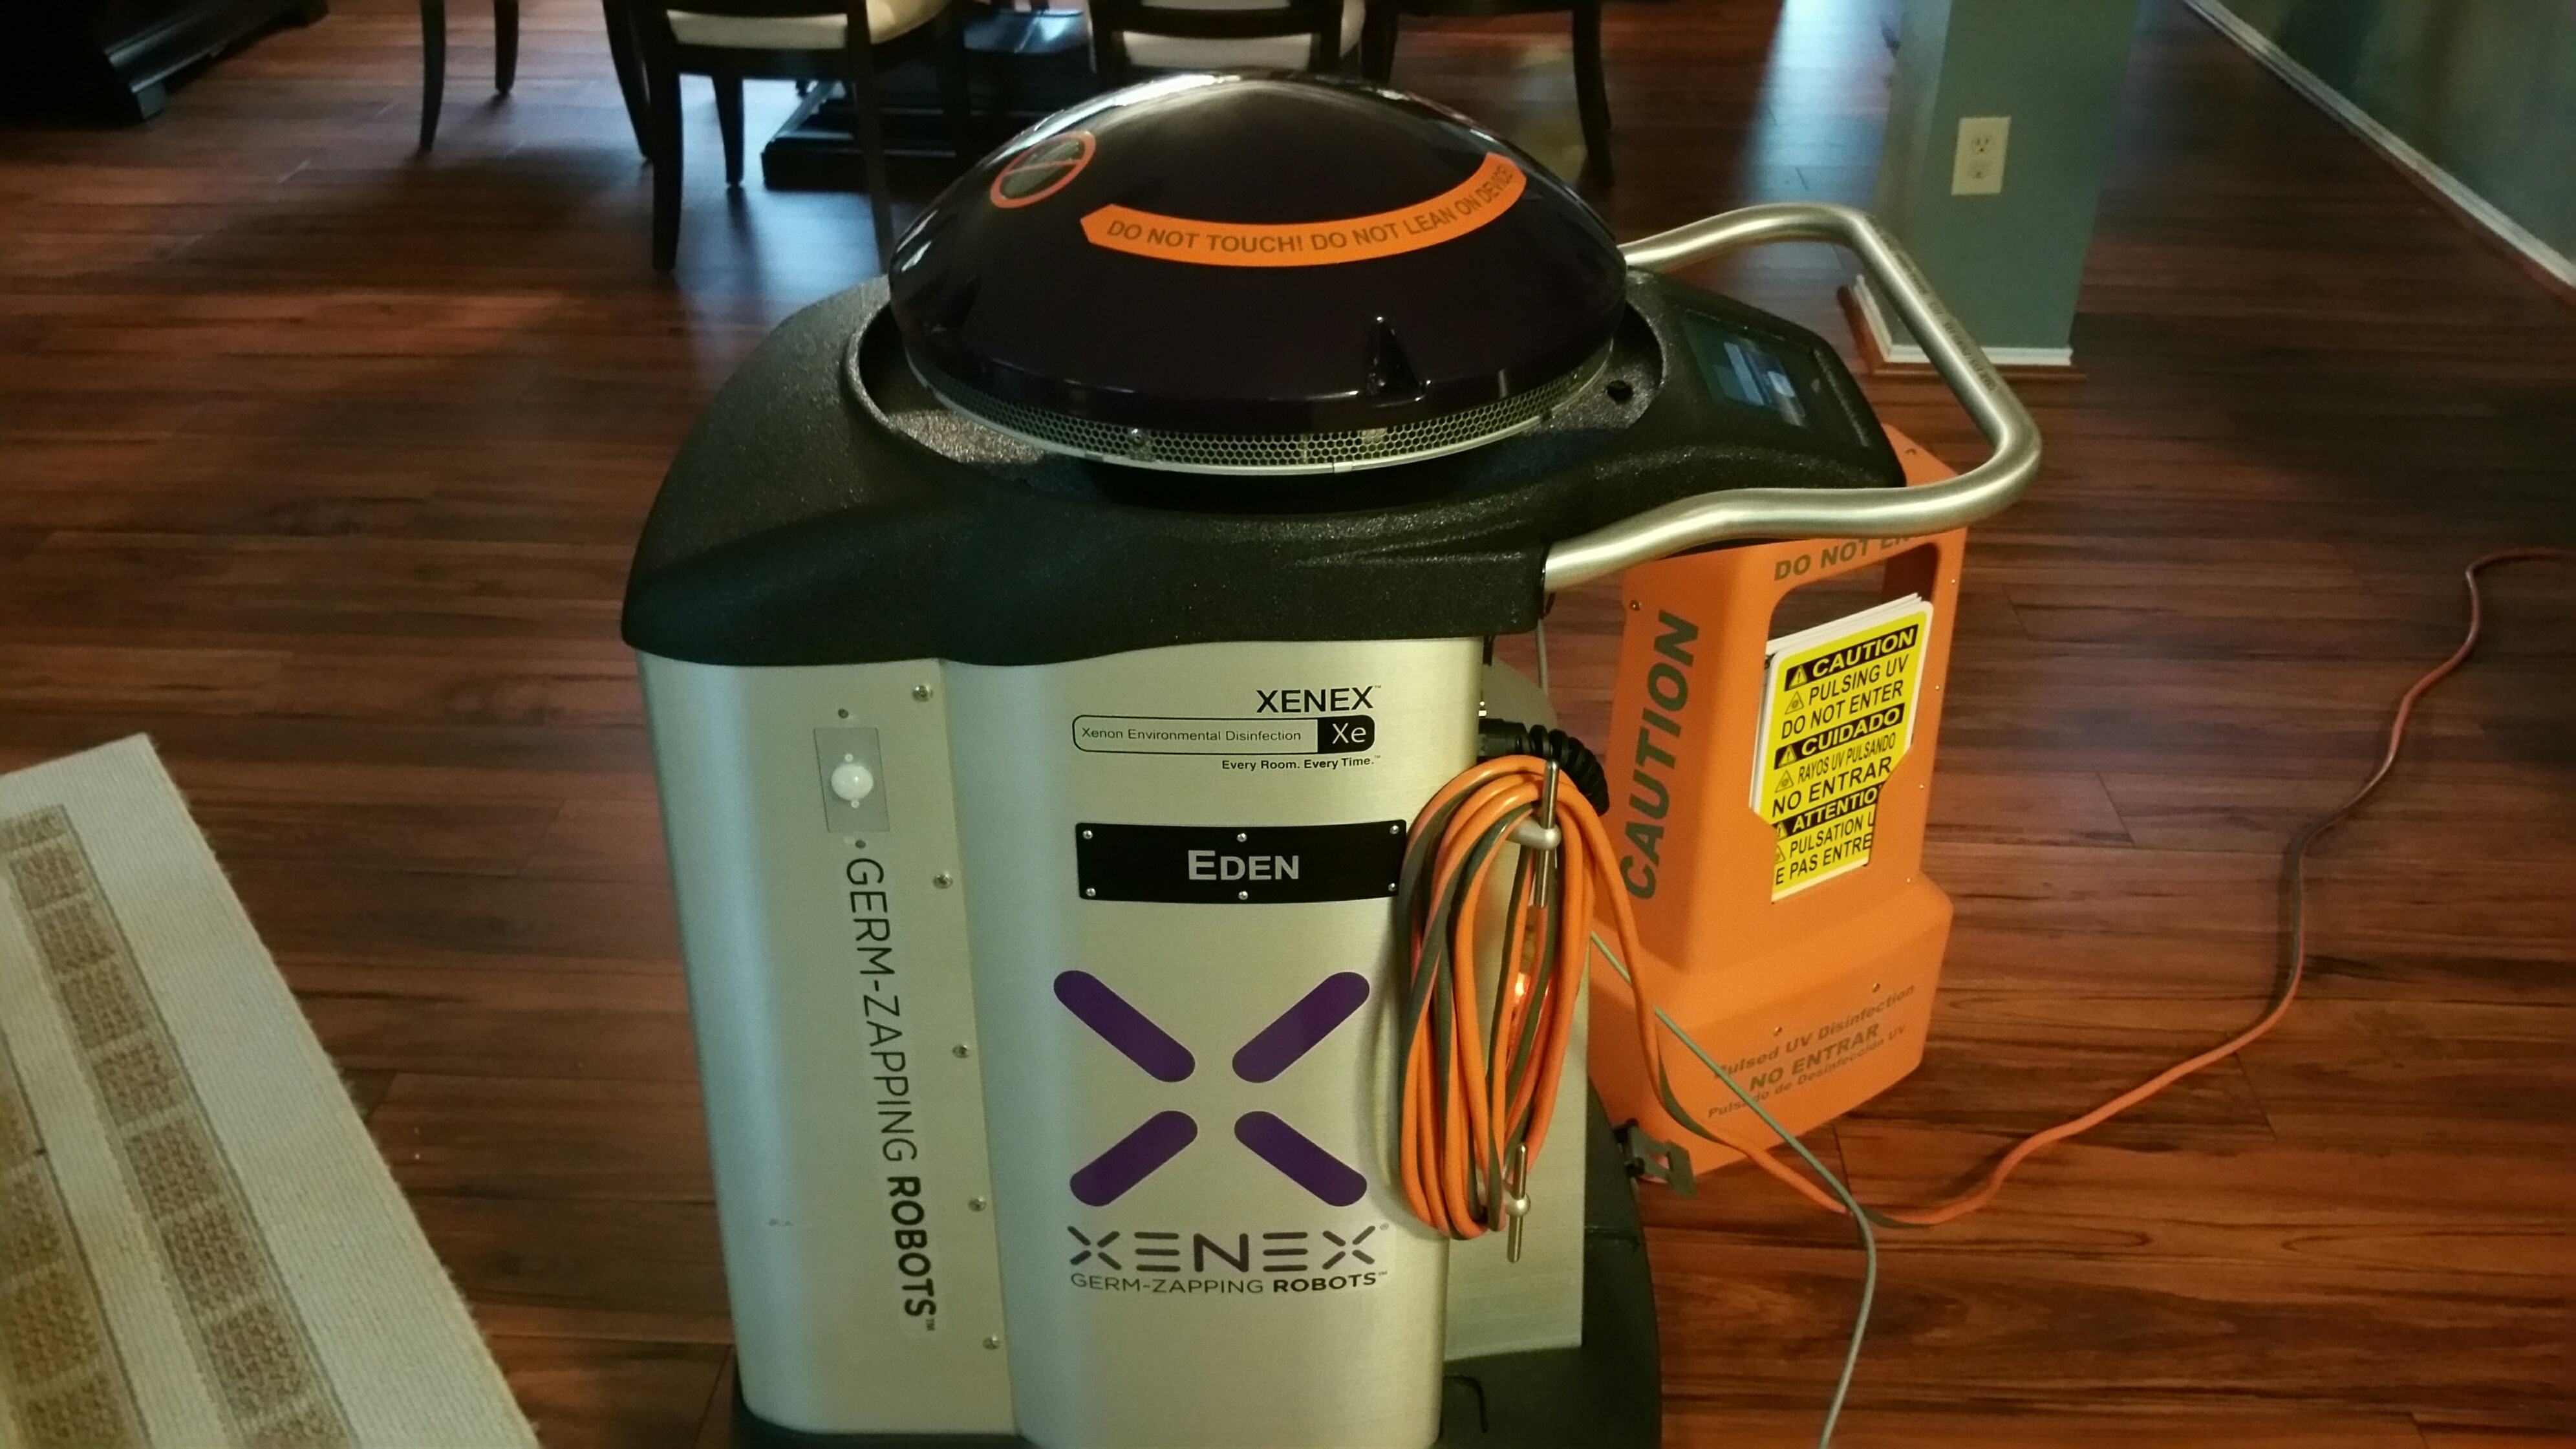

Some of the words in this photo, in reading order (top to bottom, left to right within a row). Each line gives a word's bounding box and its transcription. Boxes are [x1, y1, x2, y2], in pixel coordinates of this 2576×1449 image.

[1106, 220, 1142, 240] DO
[1147, 228, 1200, 248] NOT
[1206, 234, 1303, 253] TOUCH!
[1311, 232, 1347, 250] DO
[1352, 223, 1399, 245] NOT
[1402, 206, 1457, 234] LEAN
[1454, 195, 1483, 215] ON
[1774, 555, 1811, 581] DO
[1821, 539, 1868, 568] NOT
[1812, 628, 1914, 677] CAUTION
[1256, 686, 1373, 713] XENEX
[1809, 664, 1880, 705] PULSING
[1885, 654, 1909, 678] UV
[1082, 727, 1124, 739] Xenon
[1128, 729, 1221, 741] Environmental
[1225, 731, 1301, 741] Disinfection
[1331, 722, 1367, 744] Xe
[1782, 715, 1806, 739] DO
[1810, 700, 1845, 729] NOT
[1849, 680, 1904, 714] ENTER
[1801, 707, 1900, 756] CUIDADO
[1222, 759, 1256, 771] Every
[1261, 760, 1300, 770] Room.
[1304, 758, 1339, 770] Every
[1341, 756, 1375, 767] Time.
[1620, 610, 1699, 899] CAUTION
[1798, 757, 1829, 784] RAYOS
[1831, 750, 1848, 771] UV
[1845, 733, 1896, 769] PULSANDO
[1772, 791, 1801, 818] NO
[1809, 756, 1892, 803] ENTRAR
[1792, 786, 1879, 833] ATTENTIO
[1776, 866, 1785, 885] E
[1789, 853, 1818, 880] PAS
[1823, 832, 1873, 866] ENTRE
[1789, 814, 1863, 859] PULSATION
[1868, 811, 1874, 827] U
[1188, 850, 1300, 881] EDEN
[1785, 1032, 1813, 1053] UV
[1818, 985, 1916, 1040] Disinfection
[1750, 1067, 1784, 1091] NO
[1791, 1023, 1880, 1075] ENTRAR
[846, 857, 918, 1162] GERM-ZAPPING
[886, 1175, 937, 1318] ROBOTS
[1708, 1090, 1770, 1119] Pulsdo
[1775, 1082, 1792, 1095] de
[1067, 1225, 1375, 1272] XENEX
[1070, 1272, 1264, 1294] GERM-ZAPPING
[1272, 1272, 1377, 1293] ROBOTS
